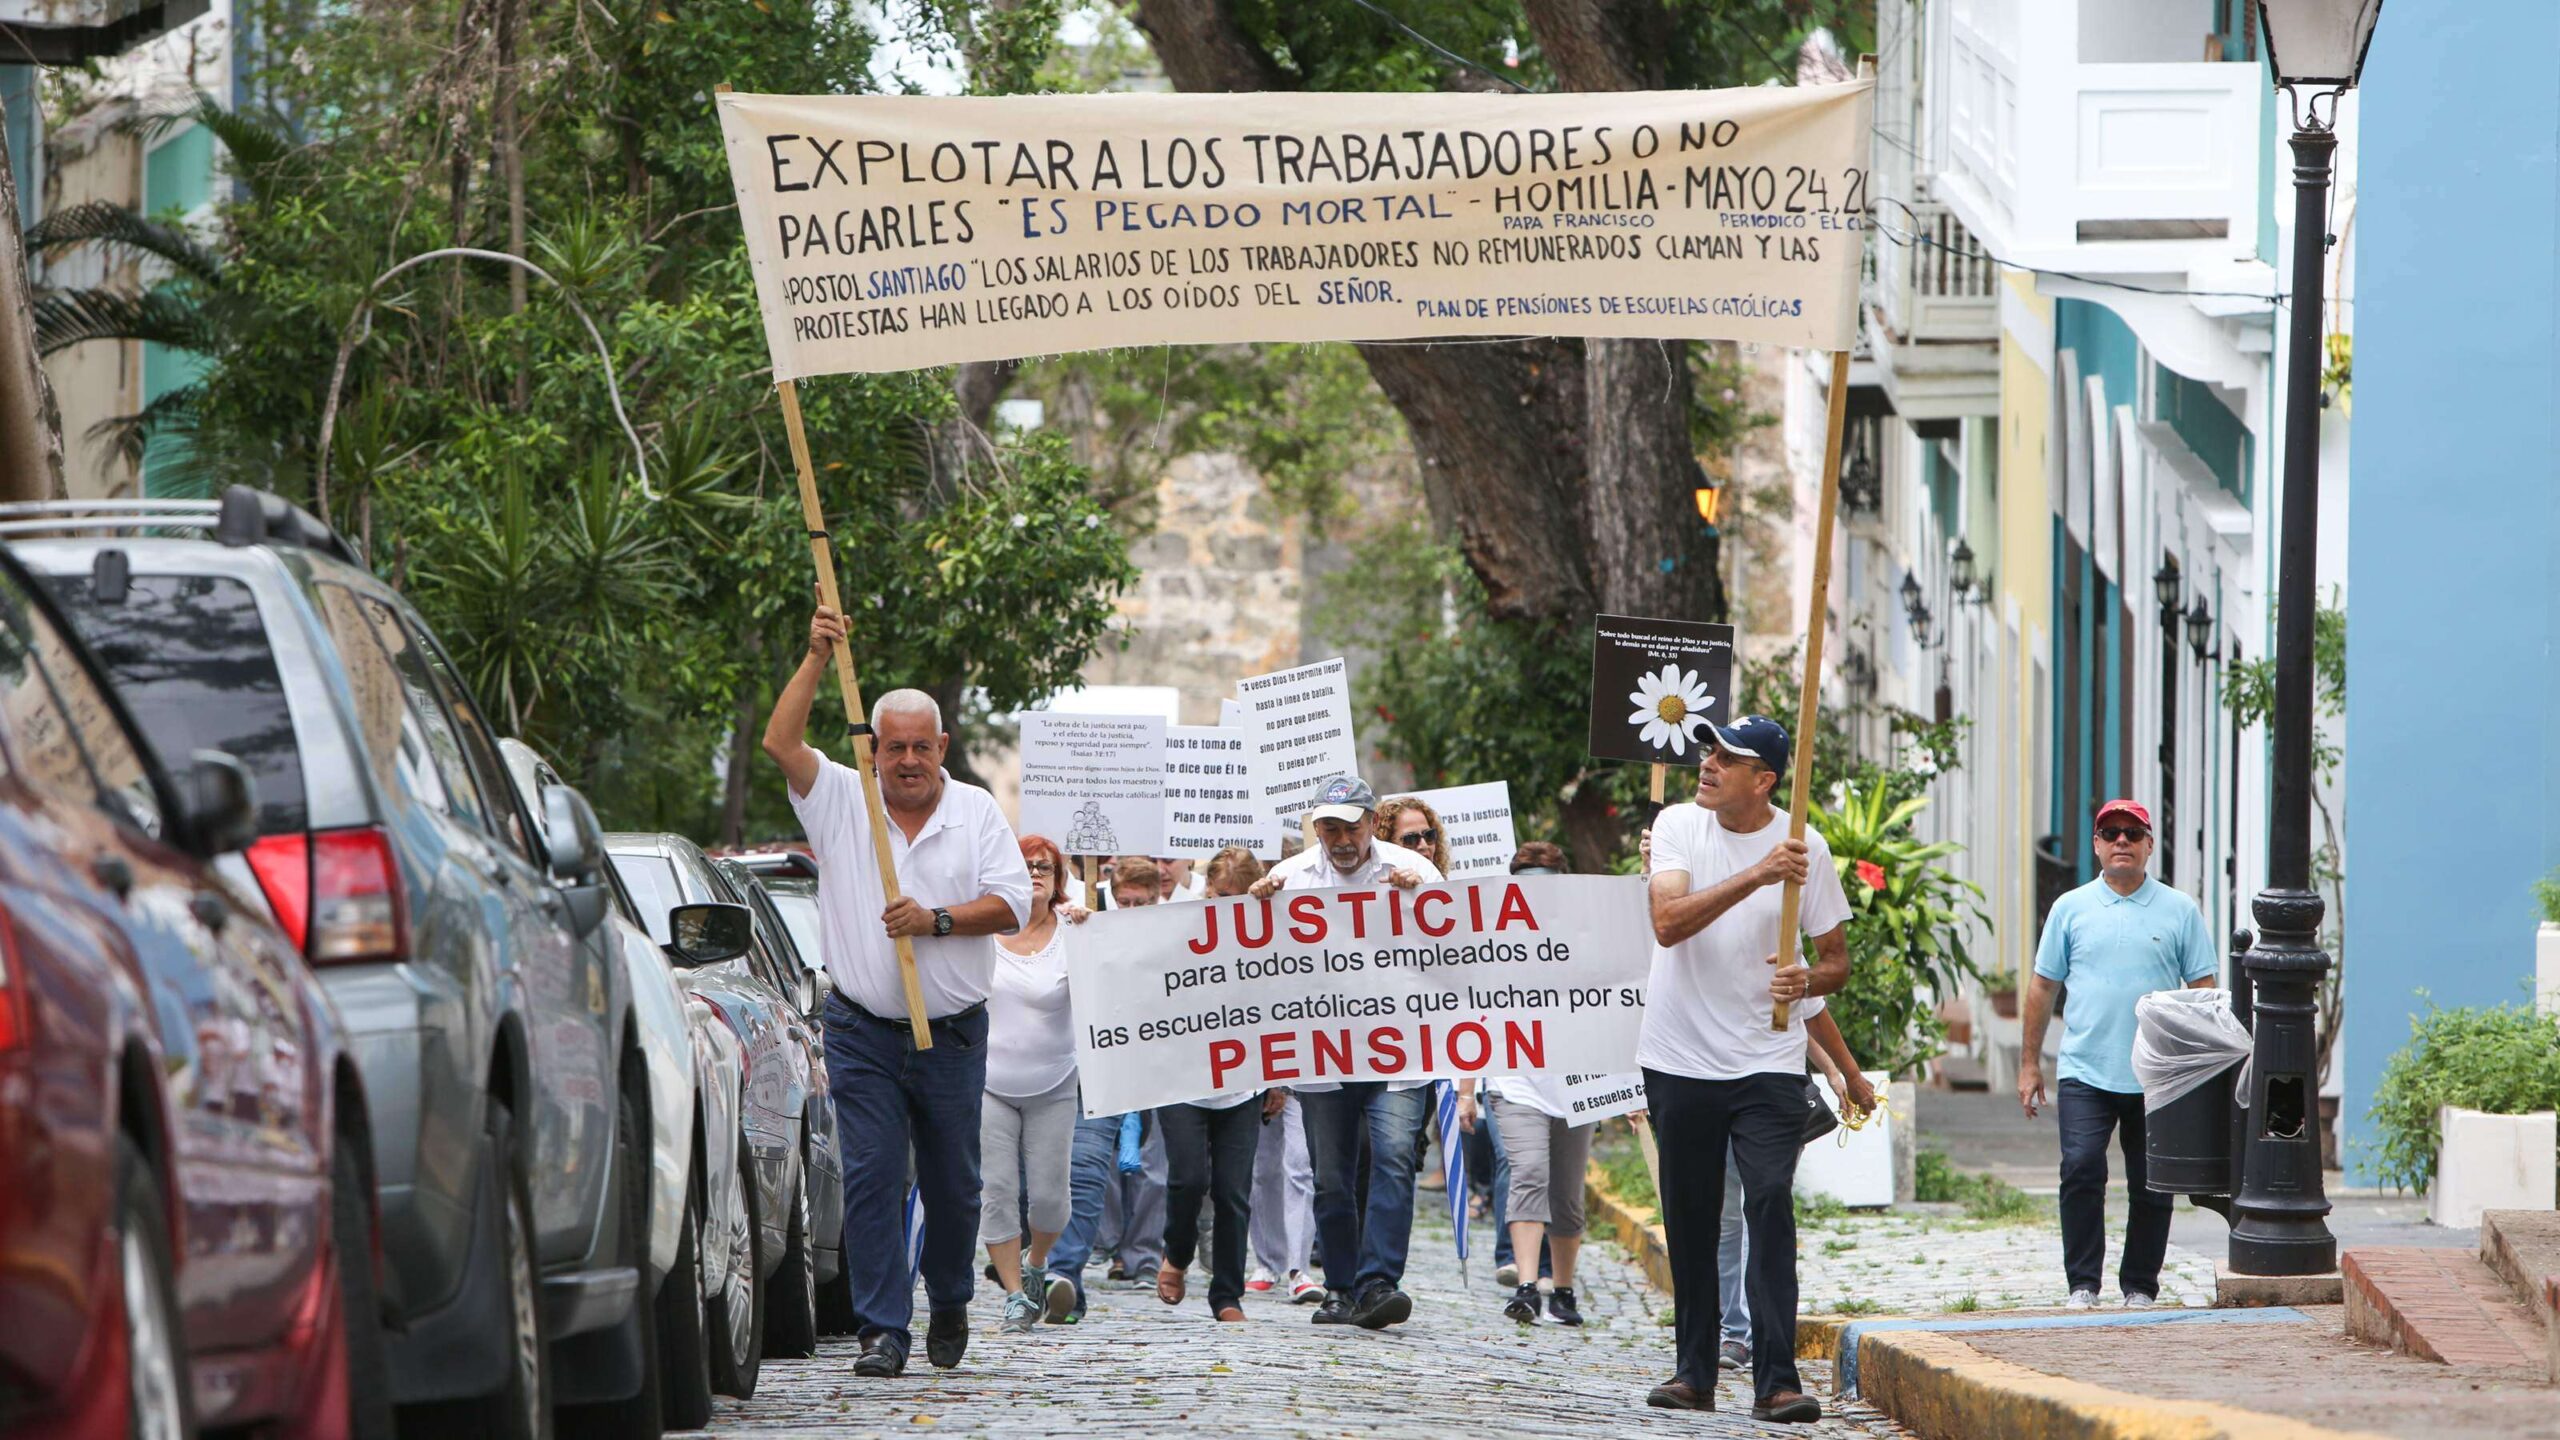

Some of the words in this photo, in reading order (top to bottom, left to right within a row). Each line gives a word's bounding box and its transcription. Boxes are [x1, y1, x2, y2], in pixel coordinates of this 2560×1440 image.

[766, 134, 1078, 192] EXPLOTAR
[1091, 139, 1122, 191] A
[1142, 136, 1226, 190] LOS
[1242, 126, 1612, 186] TRABAJADORES
[1632, 124, 1659, 159] O
[1679, 119, 1740, 152] NO
[778, 200, 975, 260] PAGARLES
[1495, 168, 1660, 213] HOMILIA
[1685, 165, 1776, 210] MAYO
[1720, 212, 1806, 228] PERIODICO
[1503, 214, 1543, 230] PAPA
[1554, 213, 1654, 229] FRANCISCO
[782, 272, 865, 307] APOSTOL
[867, 263, 967, 299] SANTIAGO
[1033, 250, 1141, 283] SALARIOS
[1151, 249, 1178, 276] DE
[1187, 247, 1229, 274] LOS
[1241, 241, 1419, 272] TRABAJADORES
[1434, 240, 1468, 267] NO
[1479, 233, 1641, 264] REMUNERADOS
[1657, 234, 1743, 261] CLAMAN
[1755, 234, 1771, 260] Y
[1780, 235, 1820, 262] LAS
[794, 307, 909, 342] PROTESTAS
[920, 302, 967, 330] HAN
[976, 293, 1068, 324] LLEGADO
[1077, 291, 1093, 314] A
[1108, 287, 1153, 312] LOS
[1163, 281, 1239, 309] OÍDOS
[1257, 282, 1300, 305] DEL
[1318, 278, 1402, 305] SEÑOR.
[1417, 300, 1461, 318] PLAN
[1466, 299, 1489, 318] DE
[1600, 297, 1622, 314] DE
[1626, 297, 1708, 315] ESCUELAS
[1251, 679, 1271, 690] veces
[1273, 675, 1287, 686] Dios
[1288, 673, 1296, 682] te
[1297, 668, 1322, 681] permite
[1324, 662, 1342, 675] llegar
[1256, 699, 1275, 712] hasta
[1276, 697, 1283, 707] la
[1302, 691, 1311, 701] de
[1091, 722, 1115, 730] justicia
[1266, 721, 1275, 731] no
[1277, 717, 1293, 729] para
[1294, 714, 1307, 725] que
[1067, 730, 1087, 738] efecto
[1260, 743, 1275, 753] sino
[1277, 740, 1292, 751] para
[1294, 736, 1306, 746] que
[1308, 732, 1323, 743] veas
[1324, 728, 1341, 740] como
[1066, 741, 1100, 749] seguridad
[1188, 738, 1198, 749] te
[1201, 739, 1226, 750] toma
[1229, 739, 1242, 750] de
[1179, 762, 1200, 774] dice
[1204, 764, 1222, 775] que
[1237, 764, 1247, 775] te
[1287, 757, 1305, 770] pelea
[1306, 754, 1318, 765] por
[1067, 777, 1083, 785] para
[1086, 776, 1107, 784] todos
[1109, 777, 1120, 785] los
[1123, 777, 1157, 785] maestros
[1265, 781, 1301, 796] Confiamos
[1303, 778, 1311, 788] en
[1024, 789, 1066, 798] empleados
[1068, 789, 1077, 797] de
[1080, 789, 1090, 798] las
[1092, 790, 1123, 798] escuelas
[1184, 789, 1196, 798] no
[1200, 788, 1233, 800] tengas
[1275, 802, 1306, 815] nuestras
[1462, 812, 1470, 822] la
[1473, 807, 1509, 822] justicia
[1173, 812, 1195, 822] Plan
[1199, 812, 1211, 824] de
[1170, 836, 1214, 848] Escuelas
[1451, 836, 1475, 847] halla
[1464, 860, 1470, 870] y
[1188, 882, 1540, 956] JUSTICIA
[1164, 960, 1227, 996] para
[1236, 947, 1314, 981] todos
[1323, 945, 1365, 973] los
[1374, 938, 1528, 980] empleados
[1536, 937, 1570, 963] de
[1089, 1024, 1130, 1049] las
[1138, 1007, 1262, 1042] escuelas
[1271, 993, 1396, 1023] católicas
[1405, 988, 1459, 1019] que
[1467, 981, 1560, 1009] luchan
[1569, 986, 1612, 1014] por
[1209, 1015, 1546, 1090] PENSIÓN
[1572, 1100, 1586, 1113] de
[1587, 1087, 1633, 1109] Escuelas
